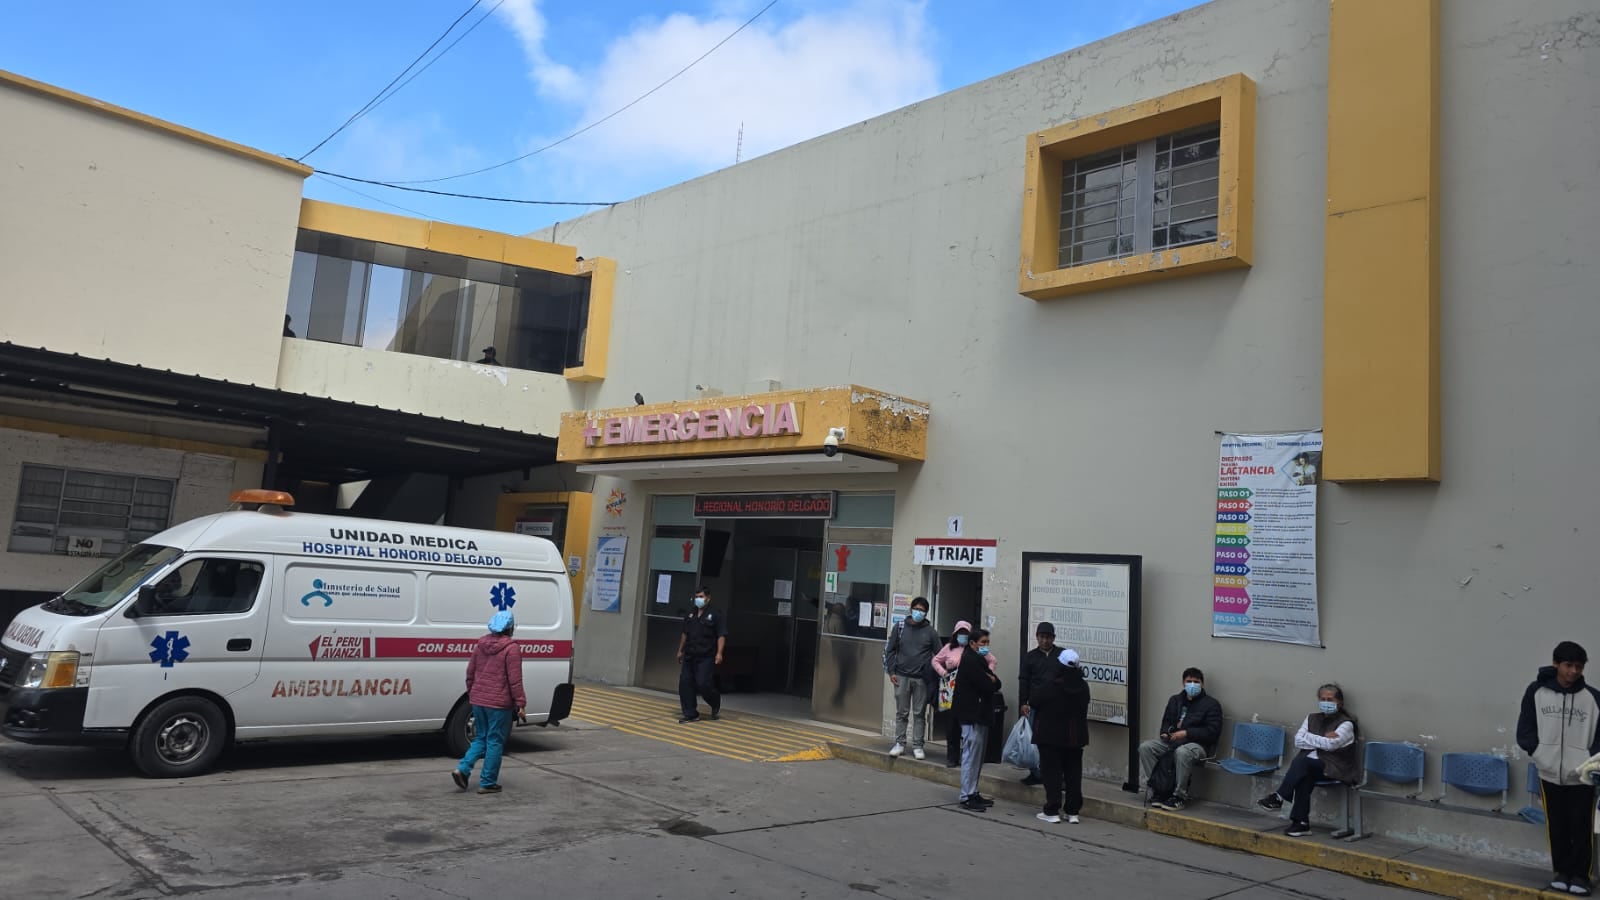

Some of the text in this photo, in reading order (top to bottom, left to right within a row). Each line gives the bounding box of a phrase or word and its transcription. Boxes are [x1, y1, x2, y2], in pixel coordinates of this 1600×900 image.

[604, 402, 800, 445] EMERGENCIA
[1220, 466, 1275, 475] LACTANCIA
[703, 500, 743, 513] REGIONAL
[745, 499, 785, 512] HONORIO
[787, 498, 830, 512] DELGADO
[952, 519, 958, 532] 1
[75, 538, 94, 549] NO
[330, 528, 478, 551] UNIDAD MEDICA
[302, 541, 503, 566] HOSPITAL HONORIO DELGADO
[938, 547, 984, 565] TRIAJE
[364, 583, 375, 592] de
[377, 585, 401, 594] Salud
[826, 574, 835, 592] 4
[1046, 578, 1076, 587] HOSPITAL
[321, 637, 362, 647] EL PERU
[1055, 626, 1125, 646] MERGENCIA ADULTOS
[321, 648, 362, 659] AVANZA
[417, 642, 443, 653] CON
[446, 643, 475, 653] SALU
[1091, 667, 1125, 683] SOCIAL
[271, 678, 413, 698] AMBULANCIA
